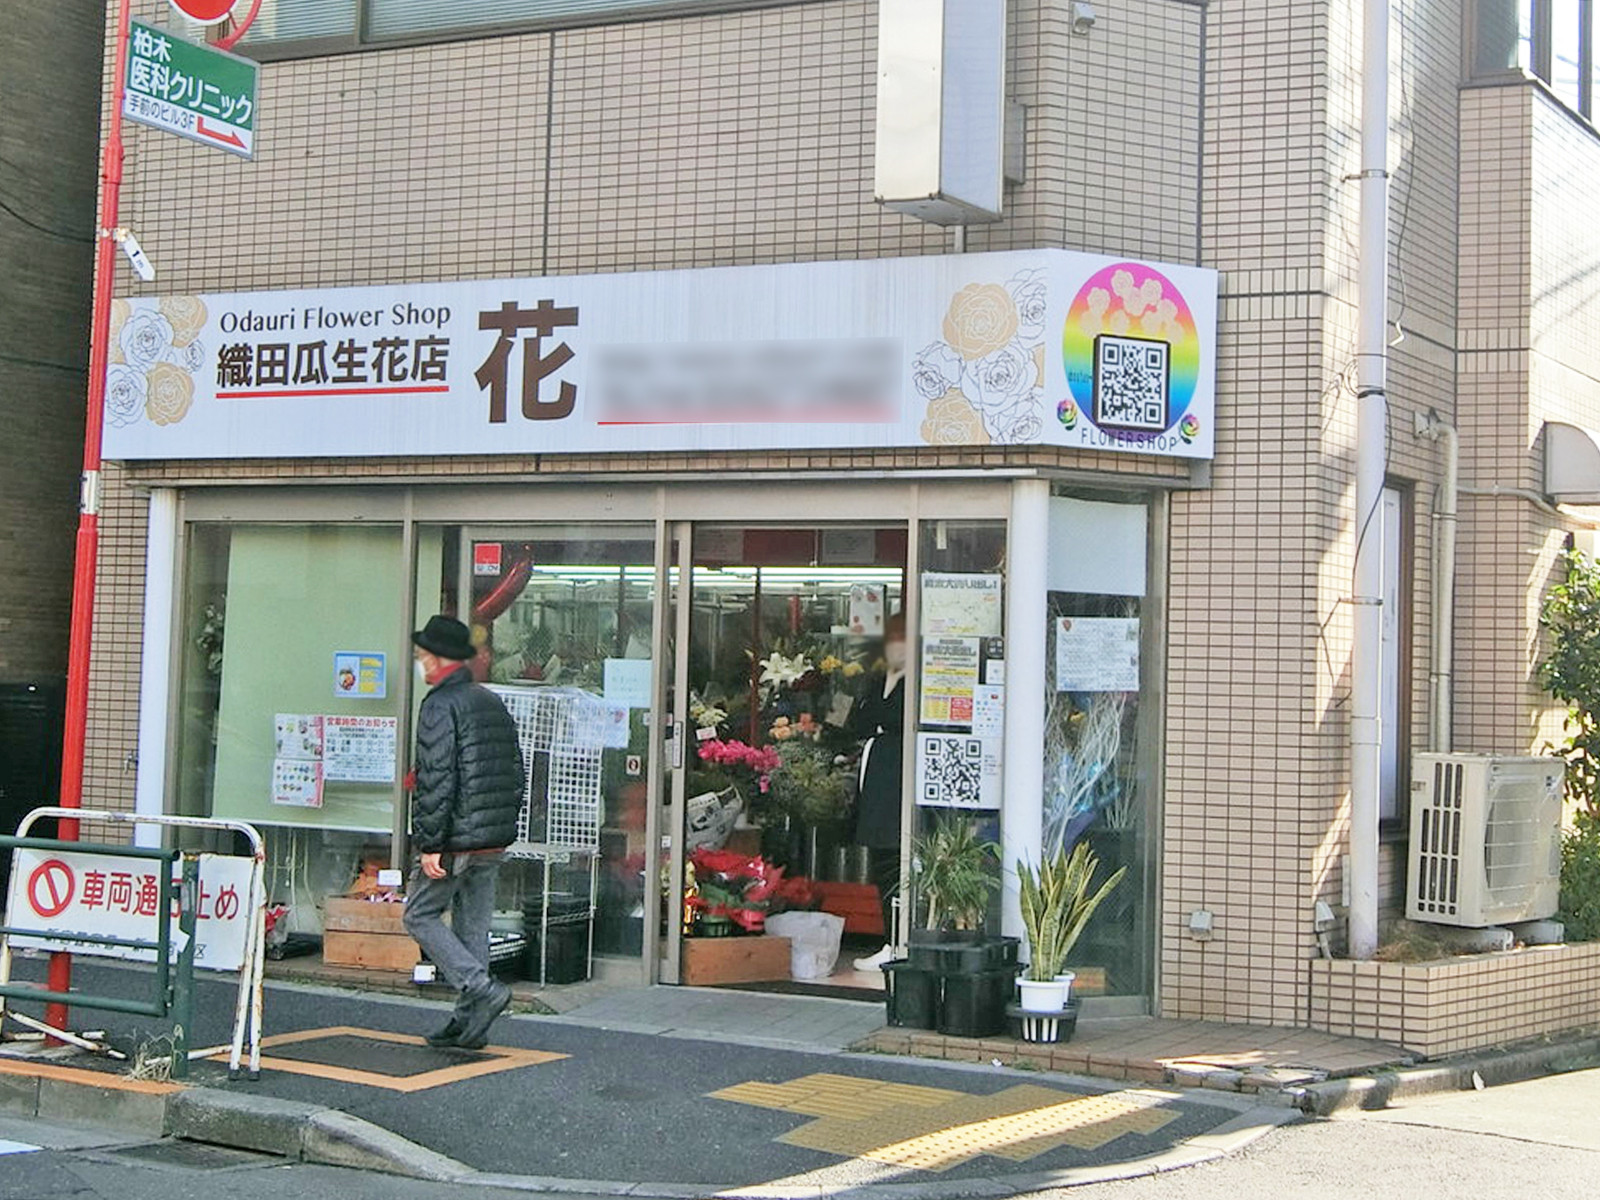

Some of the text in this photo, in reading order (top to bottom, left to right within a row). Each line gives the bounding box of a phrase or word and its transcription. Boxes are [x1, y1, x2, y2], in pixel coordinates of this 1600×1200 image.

[133, 27, 173, 63] 柏木
[129, 93, 196, 131] 手前のビル3F
[130, 56, 253, 125] 医科クリニック
[219, 302, 451, 333] Odauri Flower Shop
[215, 334, 451, 389] 織田瓜生花店
[474, 299, 579, 423] 花
